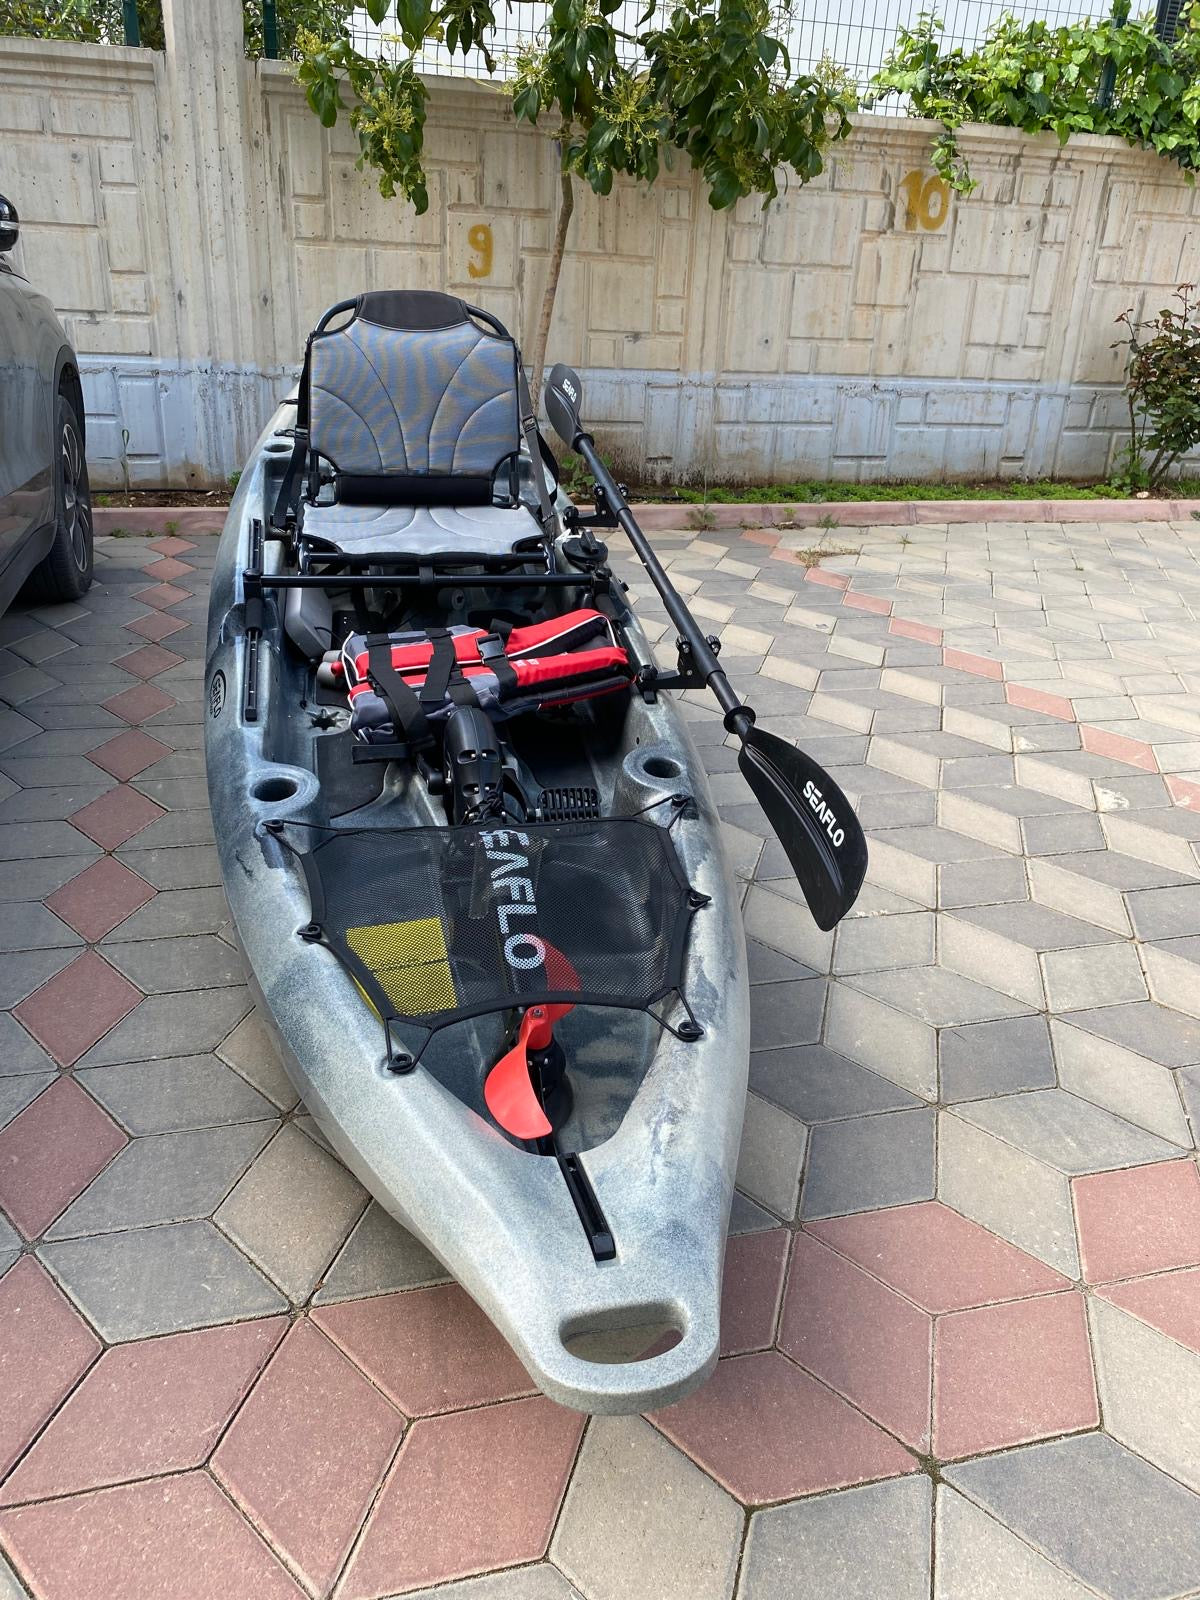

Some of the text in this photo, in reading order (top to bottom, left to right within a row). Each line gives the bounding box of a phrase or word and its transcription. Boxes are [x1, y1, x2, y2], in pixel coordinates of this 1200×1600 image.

[900, 170, 949, 231] 10
[468, 224, 493, 278] 9
[802, 780, 845, 847] SEAFLO
[478, 829, 546, 970] EAFLO
